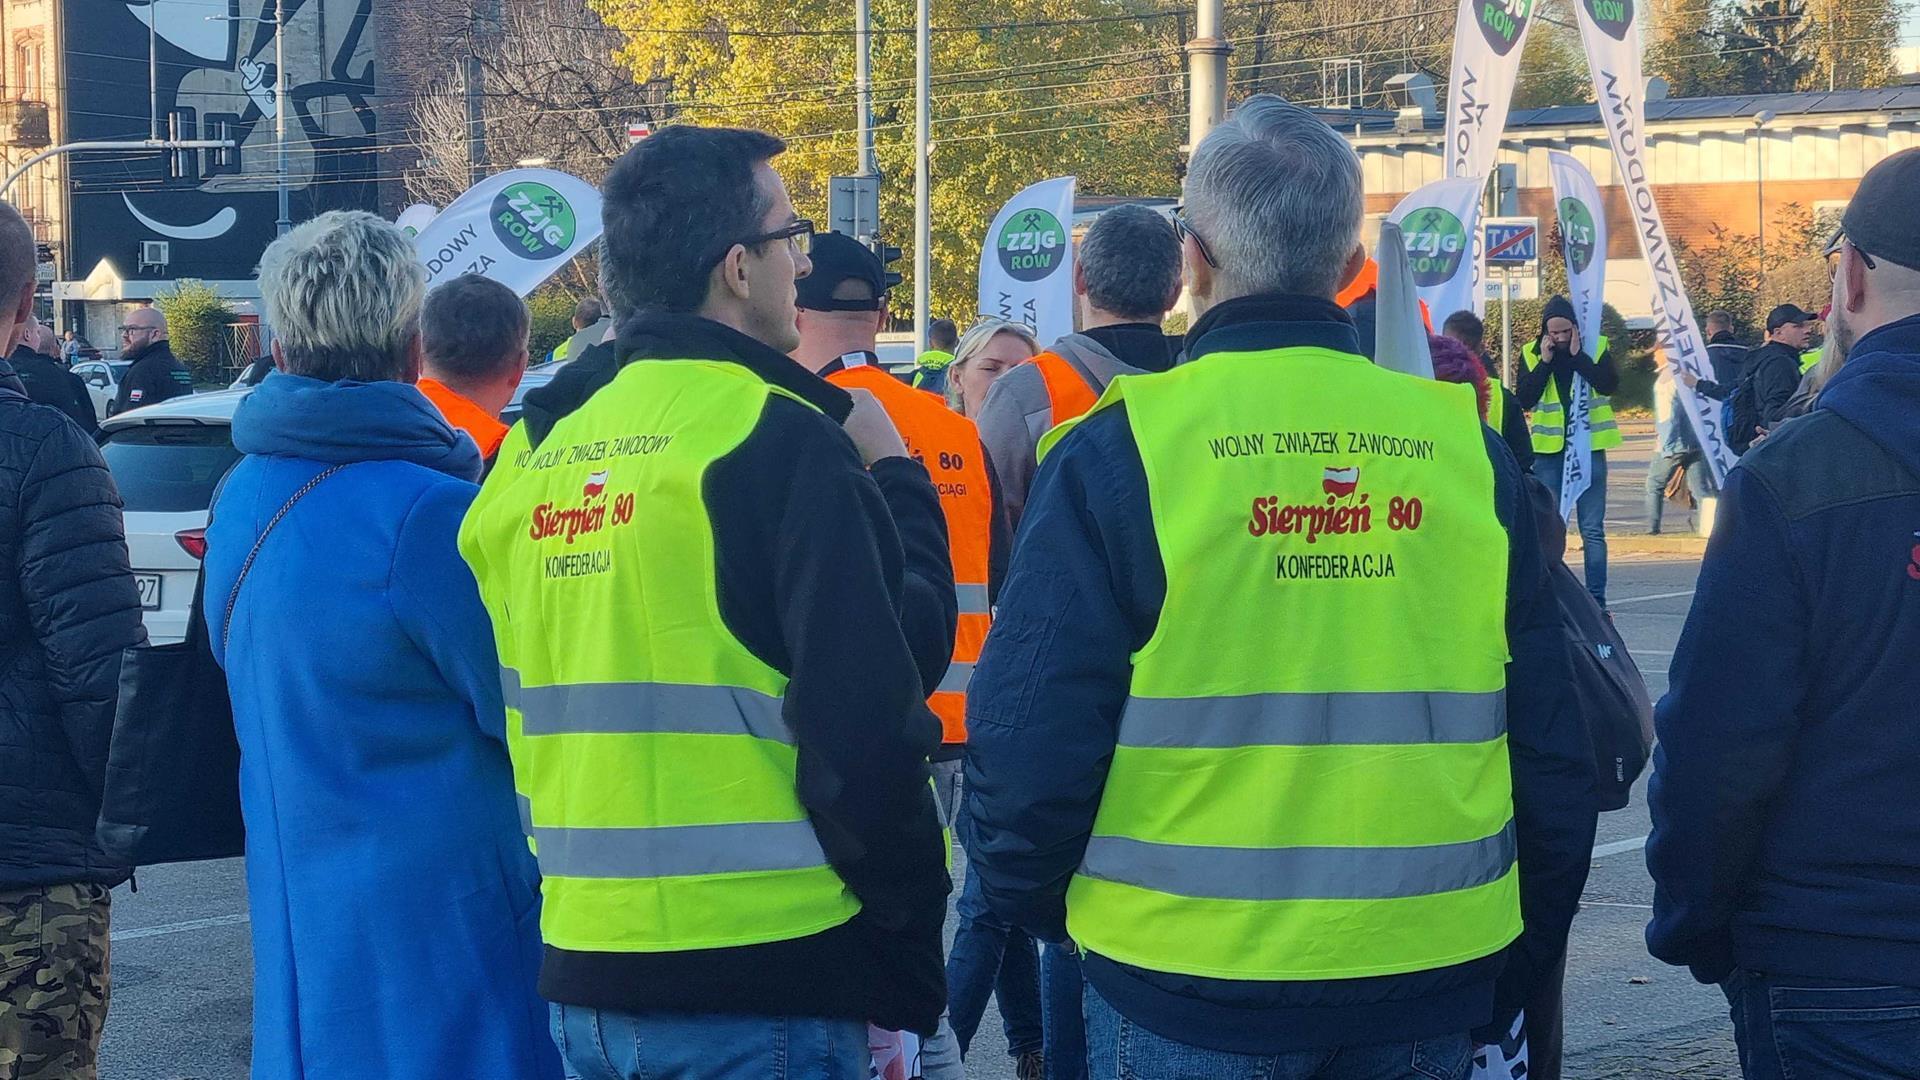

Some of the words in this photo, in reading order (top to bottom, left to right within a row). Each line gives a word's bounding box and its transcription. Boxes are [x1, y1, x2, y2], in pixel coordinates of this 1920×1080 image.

[1483, 3, 1515, 41] ROW
[1592, 0, 1624, 23] ROW
[497, 191, 565, 246] ZZJG
[497, 211, 534, 253] ROW
[1006, 230, 1056, 254] ZZJG
[1403, 232, 1458, 257] ZZJG
[1487, 228, 1535, 256] TAXI
[1011, 254, 1052, 270] ROW
[609, 435, 674, 457] ZAWODOWY
[1208, 433, 1265, 459] WOLNY
[1272, 432, 1340, 456] ZWIĄZEK
[1347, 432, 1435, 461] ZAWODOWY
[939, 451, 963, 470] 80
[933, 482, 967, 498] CIĄGI
[530, 493, 609, 545] Sierpień
[611, 492, 635, 527] 80
[1248, 493, 1372, 544] Sierpień
[1387, 495, 1423, 531] 80
[545, 549, 611, 578] KONFEDERACJA
[1276, 553, 1396, 579] KONFEDERACJA
